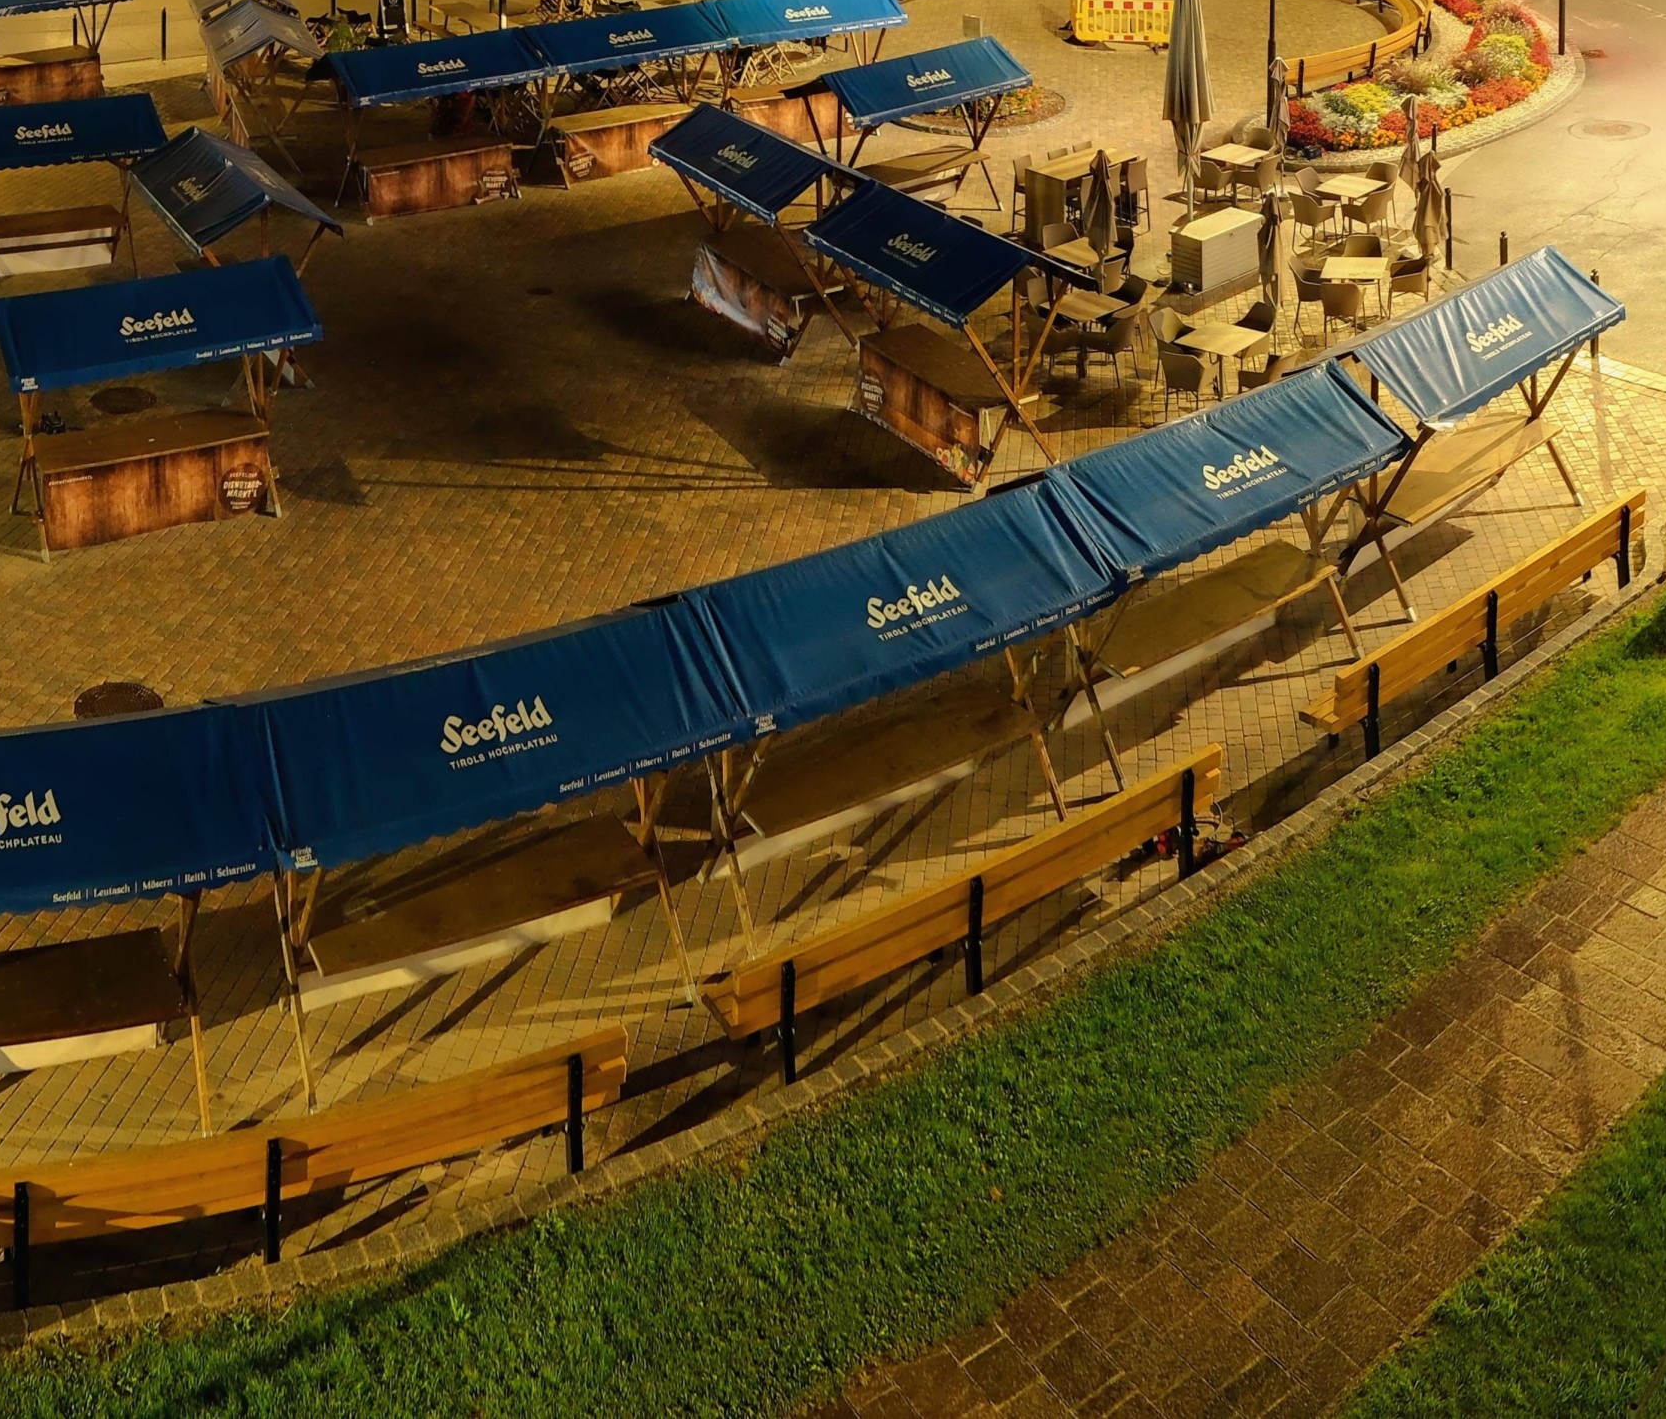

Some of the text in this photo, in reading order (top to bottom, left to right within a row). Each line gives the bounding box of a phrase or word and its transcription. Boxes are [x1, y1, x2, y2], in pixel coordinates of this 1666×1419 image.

[784, 5, 830, 20] Seefeld
[609, 28, 653, 46] Seefeld
[417, 58, 465, 74] Seefeld
[906, 68, 952, 87] Seefeld
[15, 123, 72, 140] Seefeld
[717, 143, 759, 169] Seefeld
[887, 232, 937, 262] Seefeld
[120, 307, 194, 336] Seefeld
[125, 327, 197, 344] TIROLS HOCHPLATEAU
[1466, 313, 1524, 354] Seefeld
[1202, 444, 1280, 491] Seefeld
[1216, 466, 1288, 501] TIROLS HOCHPLATEAU
[866, 574, 961, 629] Seefeld
[878, 603, 969, 642] TIROLS HOCHPLATEAU
[975, 636, 996, 652] Seefeld
[1003, 625, 1030, 641] Leutasch
[440, 695, 553, 754] Seefeld
[449, 733, 559, 771] TIROLS HOCHPLATEAU
[559, 731, 732, 793] Seefeld Leutasch Mösern Reith Scharnitz
[52, 861, 257, 903] Seefeld Leutasch Mösern Reith Scharnitz
